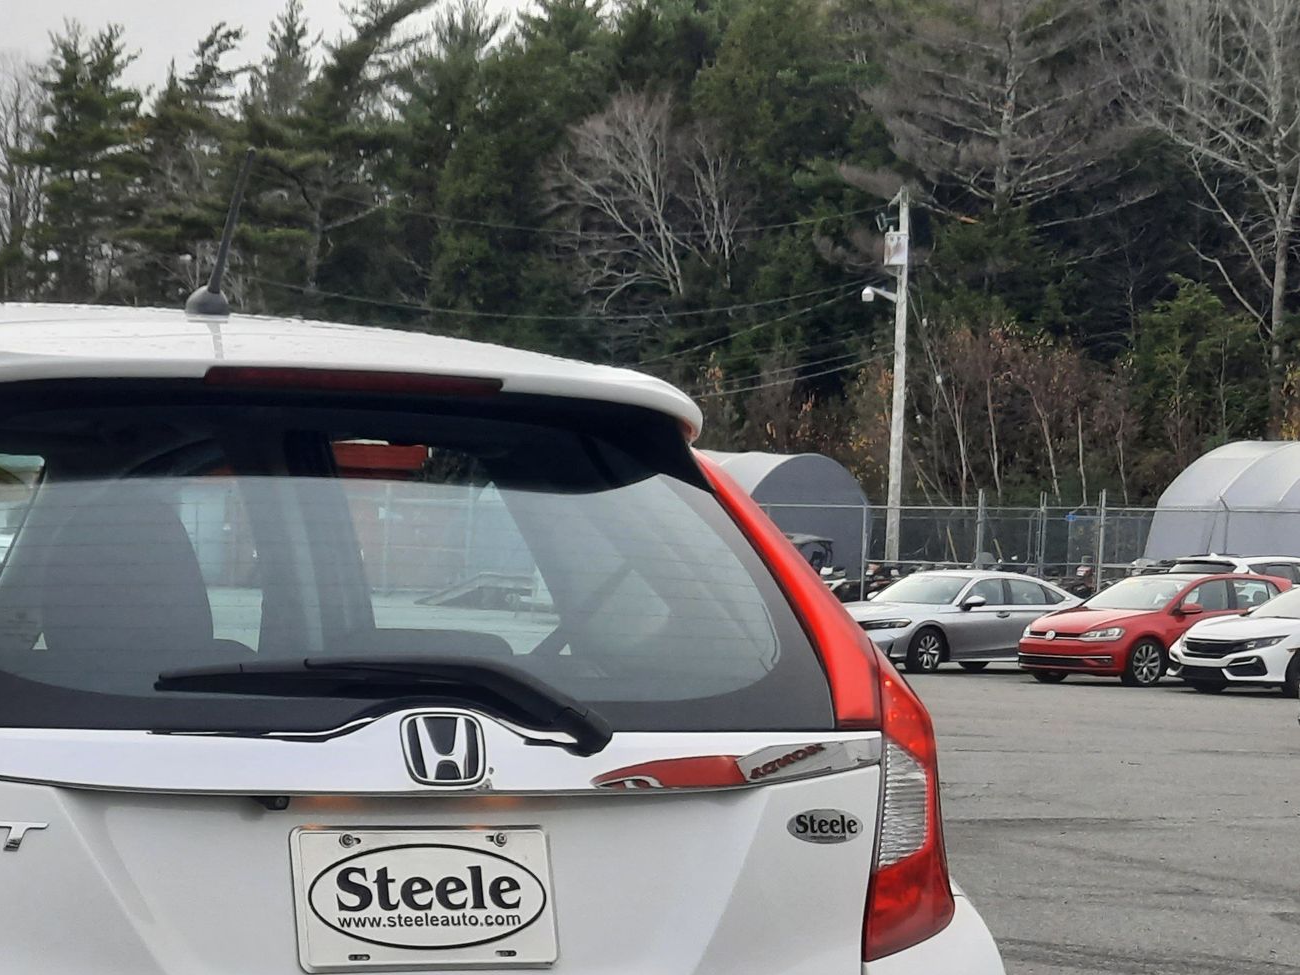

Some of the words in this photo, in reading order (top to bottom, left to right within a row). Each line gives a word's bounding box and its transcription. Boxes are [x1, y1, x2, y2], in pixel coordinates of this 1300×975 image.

[795, 814, 858, 834] Steele
[336, 865, 521, 912] Steele
[338, 912, 521, 928] www.steeleauto.com
